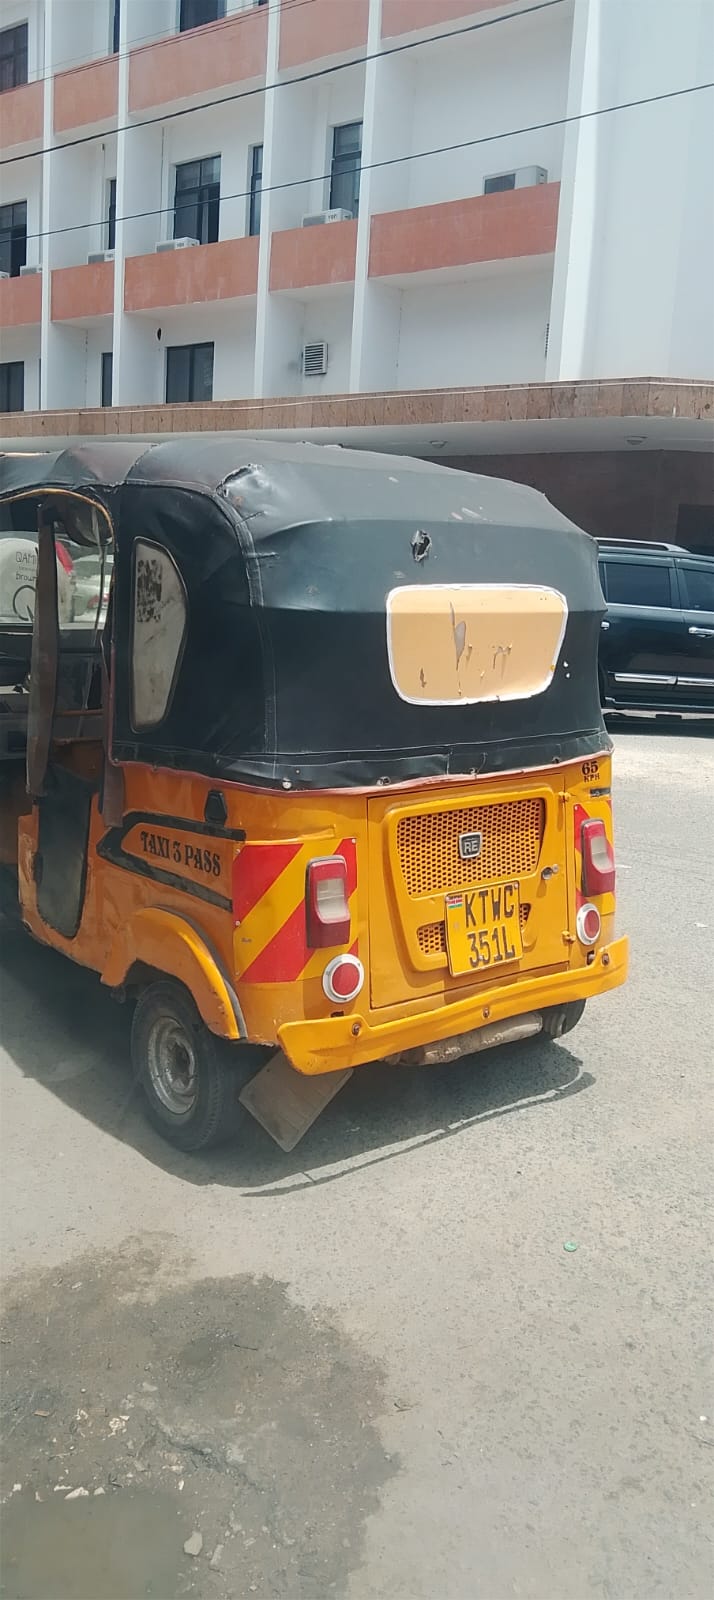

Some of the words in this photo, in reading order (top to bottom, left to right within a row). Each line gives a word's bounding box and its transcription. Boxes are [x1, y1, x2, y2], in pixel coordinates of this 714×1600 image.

[581, 760, 599, 776] 65
[583, 772, 600, 783] KPH
[140, 830, 170, 859] TAXI
[184, 844, 221, 877] PASS
[463, 839, 479, 854] RE
[464, 884, 515, 929] KTWC
[467, 925, 516, 968] 351L
